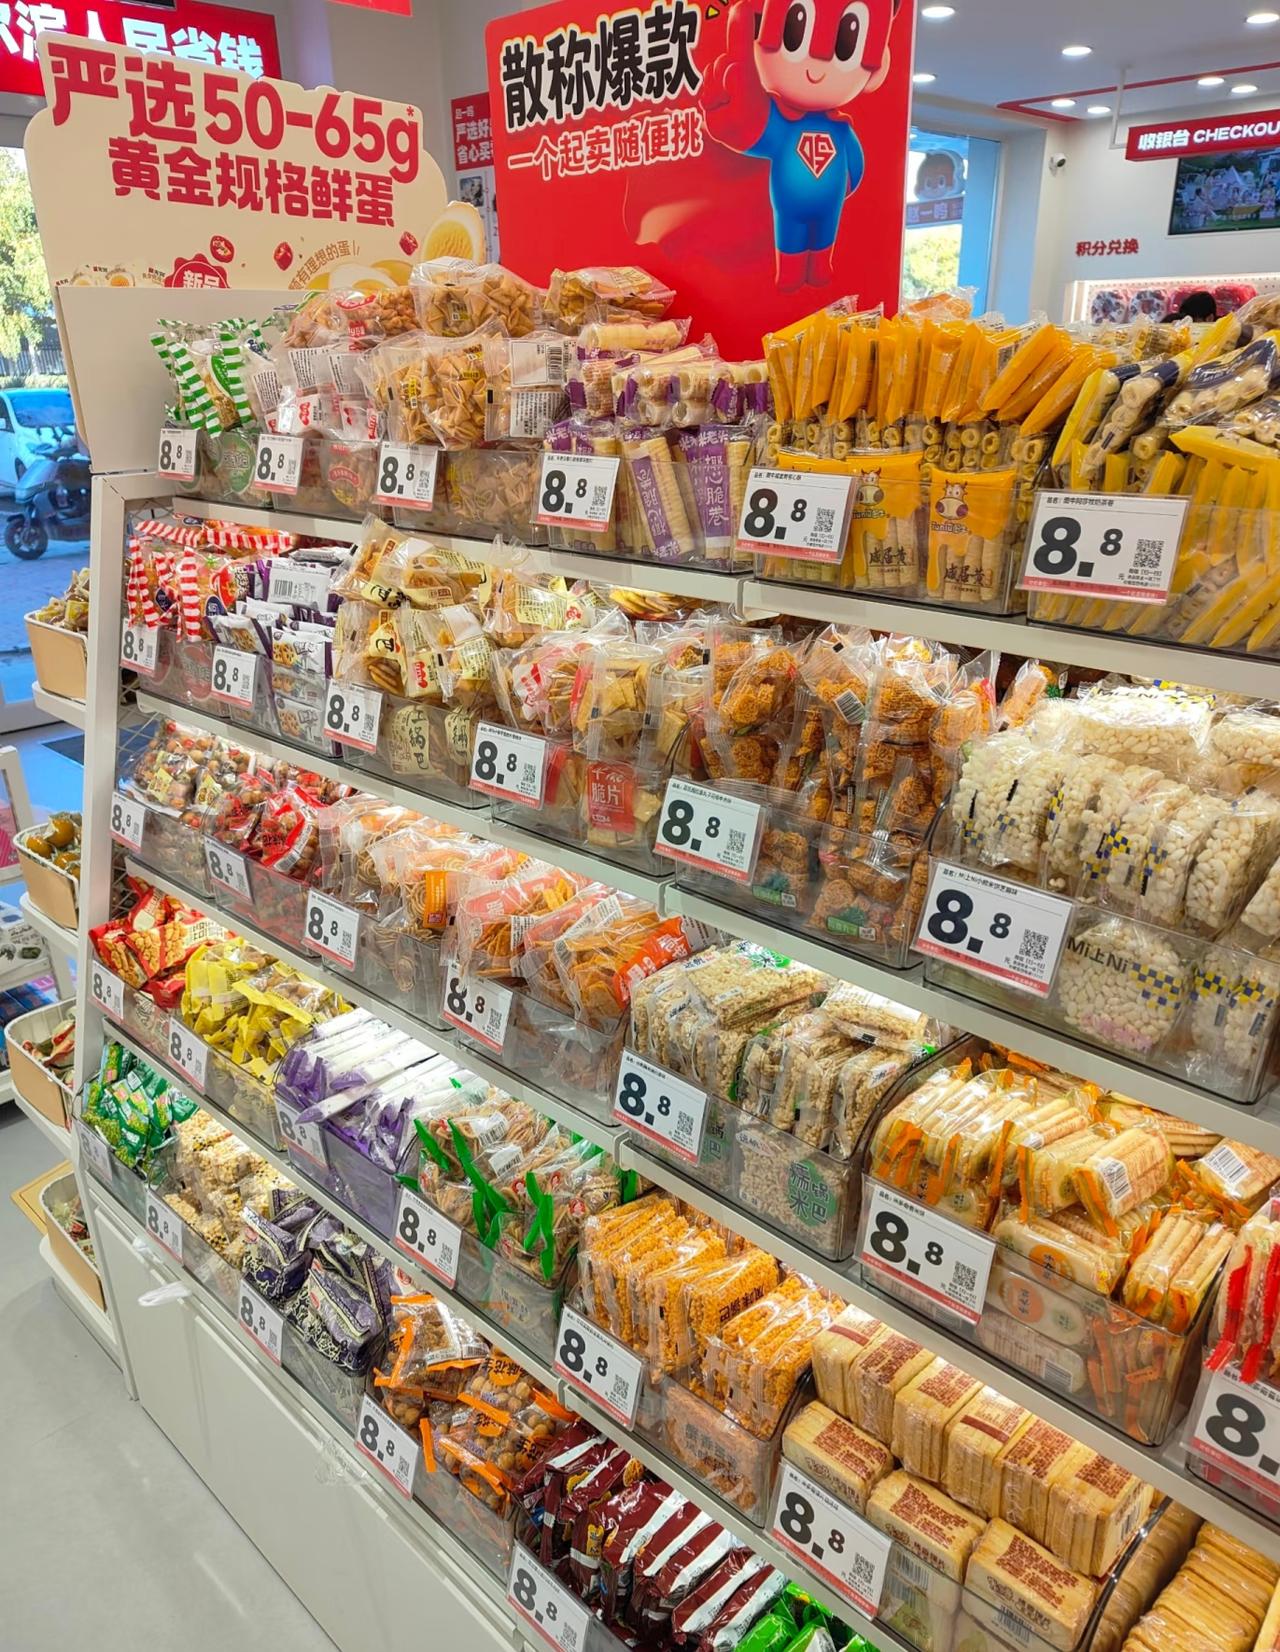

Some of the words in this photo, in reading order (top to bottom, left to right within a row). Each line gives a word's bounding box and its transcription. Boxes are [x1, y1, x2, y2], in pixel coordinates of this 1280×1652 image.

[502, 2, 700, 128] 散称爆款
[455, 118, 492, 143] 严选好
[508, 112, 702, 179] 一个起卖随便挑
[1138, 130, 1189, 151] 收银台
[456, 140, 494, 164] 省心买
[108, 136, 396, 228] 黄金规格鲜蛋
[1075, 238, 1139, 258] 积分兑换
[160, 440, 183, 471] 8.8
[258, 447, 285, 480] 8.8
[380, 457, 415, 495] 8.8
[542, 470, 588, 514] 8.8
[744, 489, 808, 539] 8.8
[1033, 517, 1124, 578] 8.8
[123, 631, 145, 661] 8.8
[214, 659, 239, 692] 8.8
[327, 694, 360, 733] 8.8
[475, 741, 518, 784] 8.8
[591, 783, 621, 806] 脆片
[112, 804, 132, 835] 8.8
[662, 800, 721, 851] 8.8
[209, 851, 234, 883] 8.8
[308, 907, 339, 945] 8.8
[928, 889, 1013, 953] 8.8
[94, 973, 112, 1003] 8.8
[447, 978, 486, 1023] 8.8
[171, 1032, 193, 1067] 8.8
[619, 1073, 671, 1125] 8.8
[279, 1111, 308, 1146] 8.8
[790, 1161, 811, 1218] 糯米
[810, 1180, 830, 1225] 锅巴
[148, 1205, 169, 1239] 8.8
[399, 1207, 437, 1254] 8.8
[870, 1211, 945, 1276] 8.8
[241, 1296, 266, 1335] 8.8
[560, 1329, 609, 1384] 8.8
[360, 1415, 395, 1461] 8.8
[780, 1492, 846, 1560] 8.8
[513, 1568, 558, 1625] 8.8
